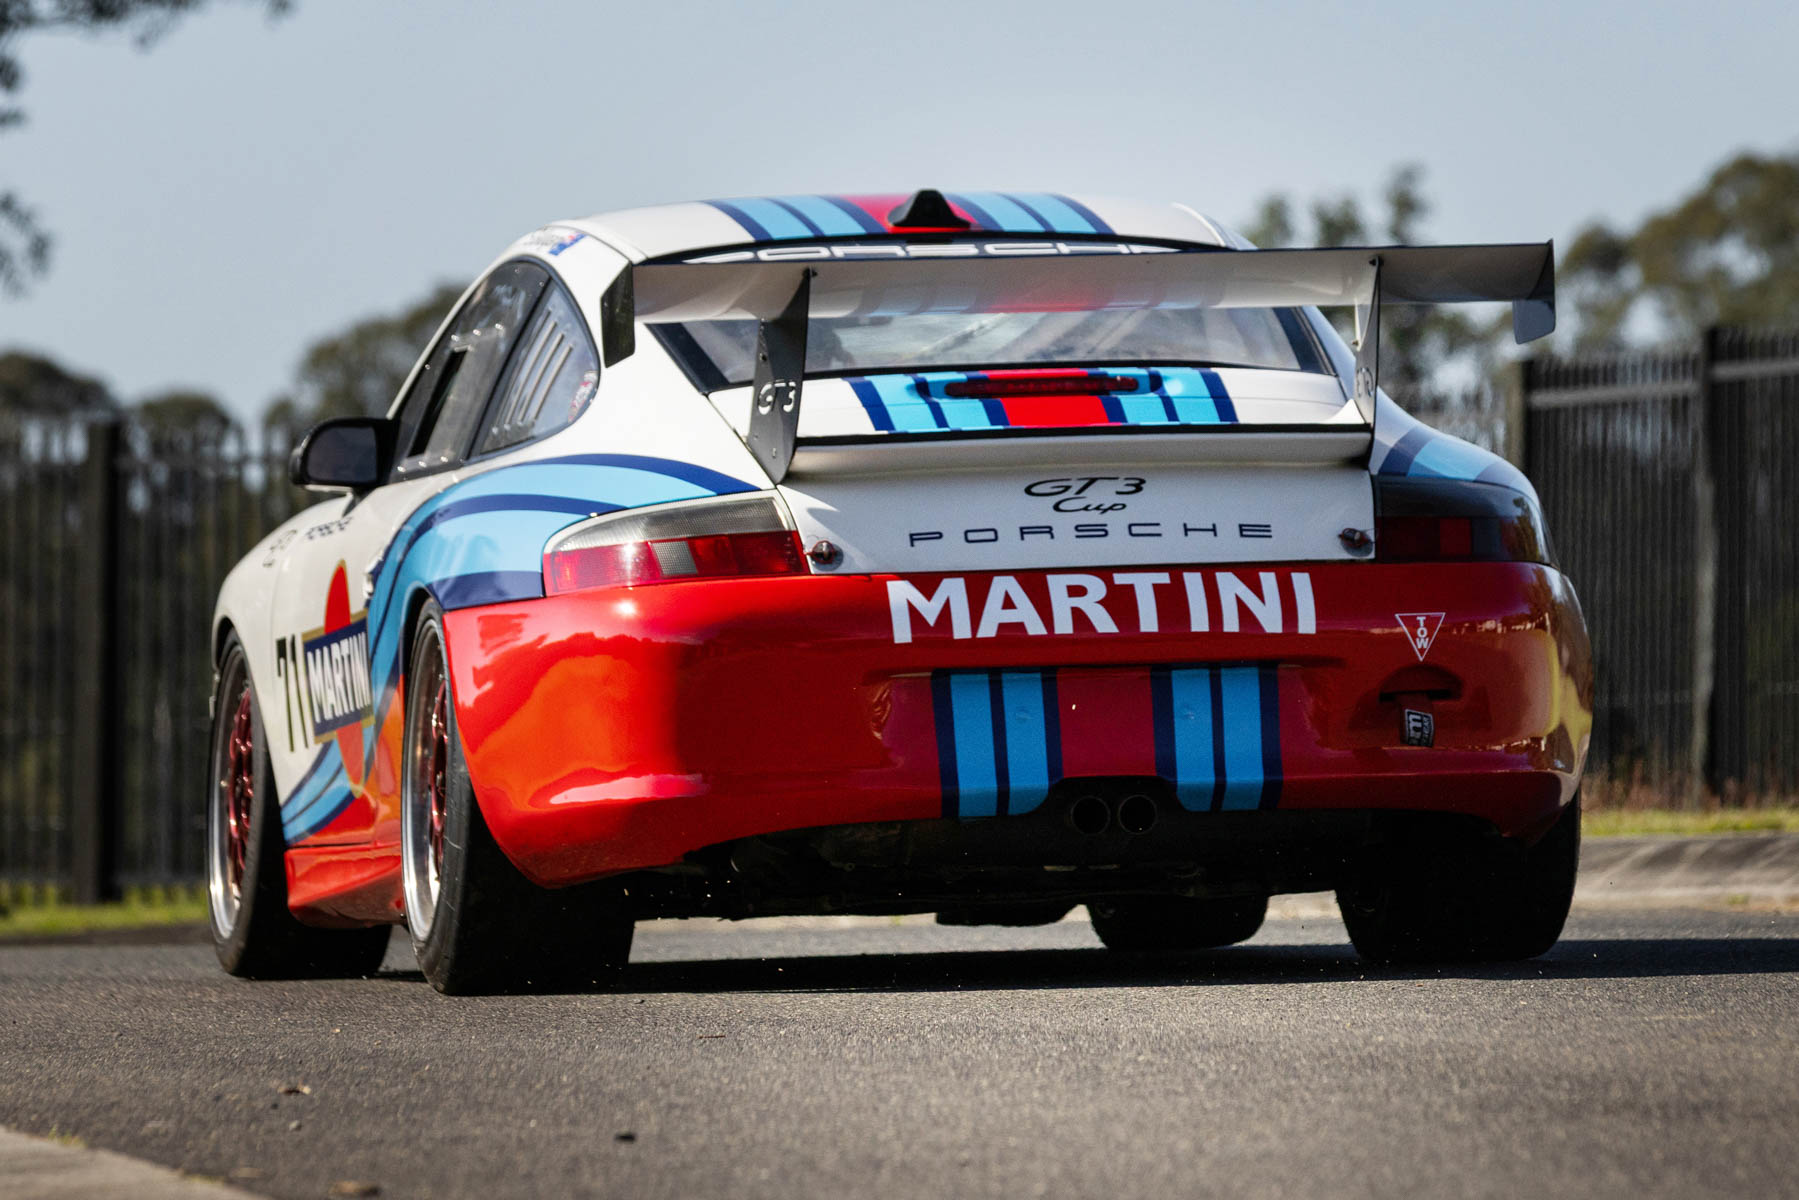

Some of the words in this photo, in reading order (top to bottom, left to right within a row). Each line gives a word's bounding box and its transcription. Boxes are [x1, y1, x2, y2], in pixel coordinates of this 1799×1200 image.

[758, 380, 797, 415] GT3
[1052, 496, 1127, 515] Cup
[909, 522, 1273, 547] PORSCHE
[886, 571, 1317, 644] MARTINI
[1416, 616, 1429, 649] TOW
[276, 634, 309, 752] 71
[307, 631, 371, 724] MARTINI
